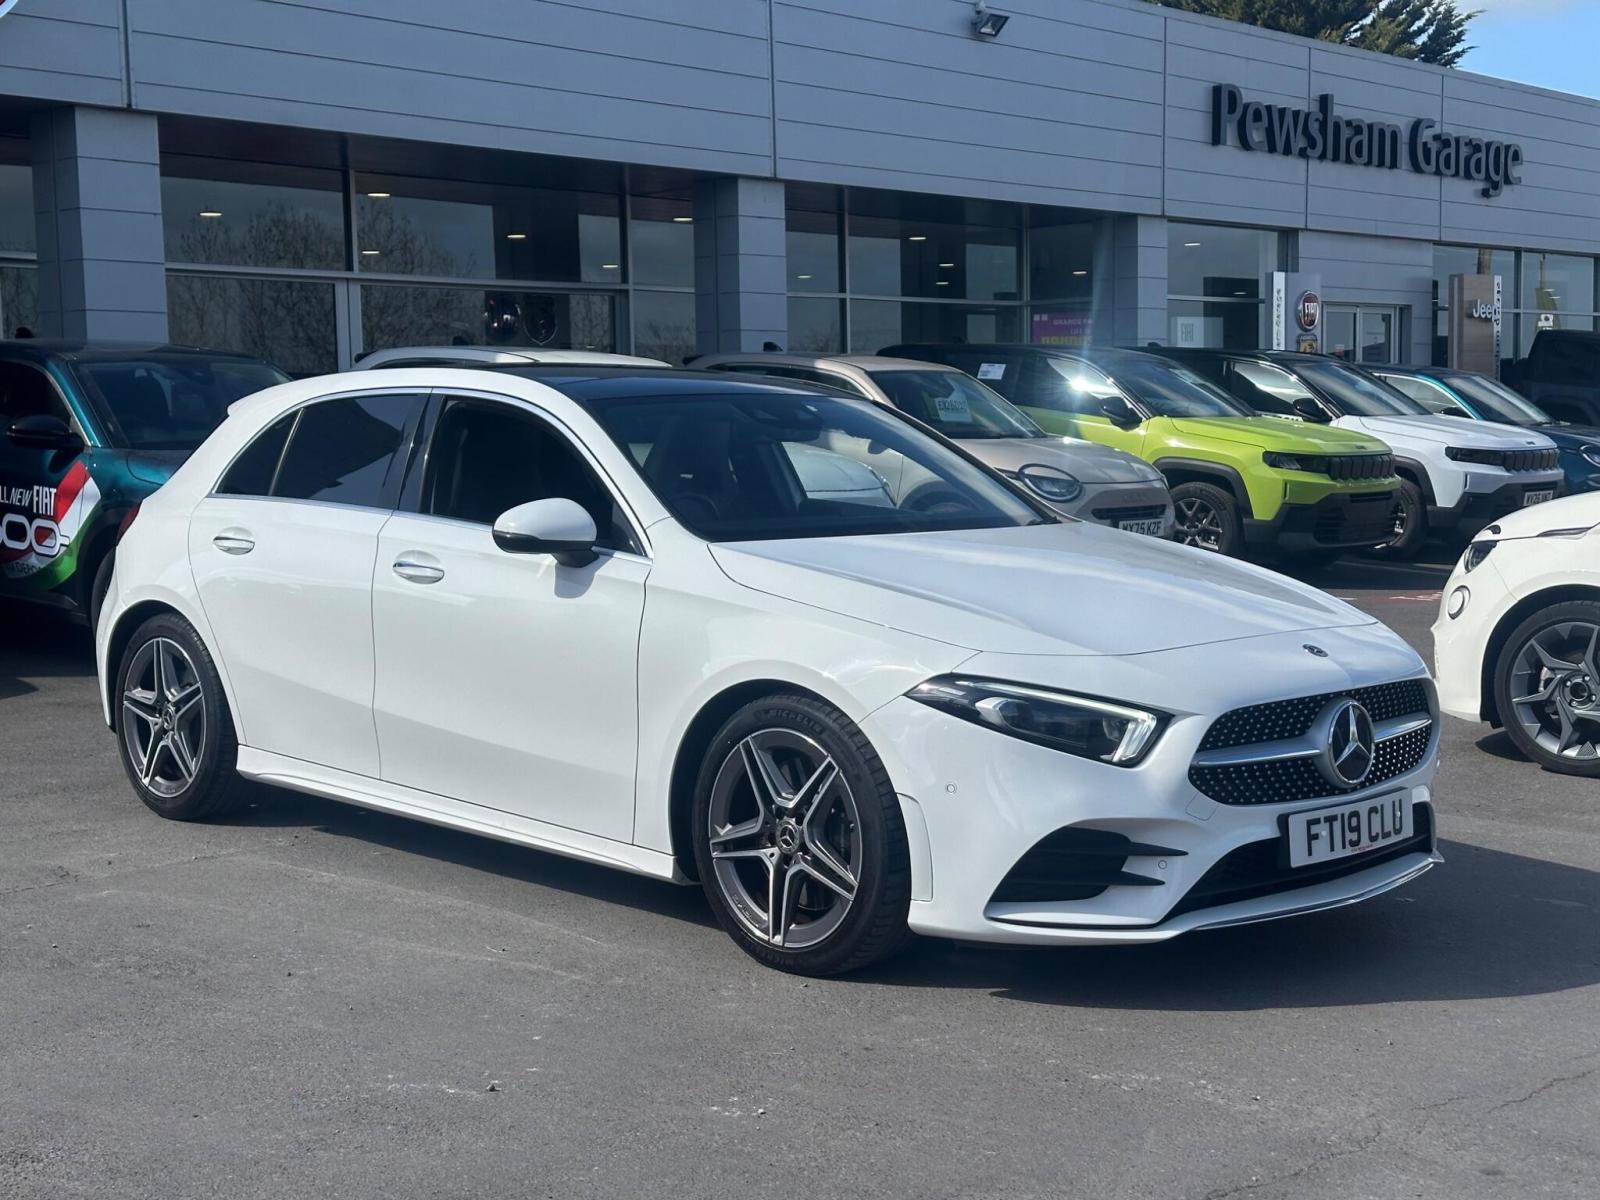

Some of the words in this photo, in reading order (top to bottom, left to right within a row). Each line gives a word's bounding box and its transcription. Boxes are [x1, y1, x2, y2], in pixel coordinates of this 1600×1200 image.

[1212, 83, 1402, 169] Pewsham
[1409, 117, 1524, 198] Garage
[1473, 299, 1500, 322] Jeep
[0, 485, 9, 504] LL
[9, 487, 33, 507] NEW
[33, 485, 57, 516] FIAT
[0, 513, 61, 558] 00
[1306, 810, 1362, 857] FT19
[1368, 799, 1402, 842] CLU
